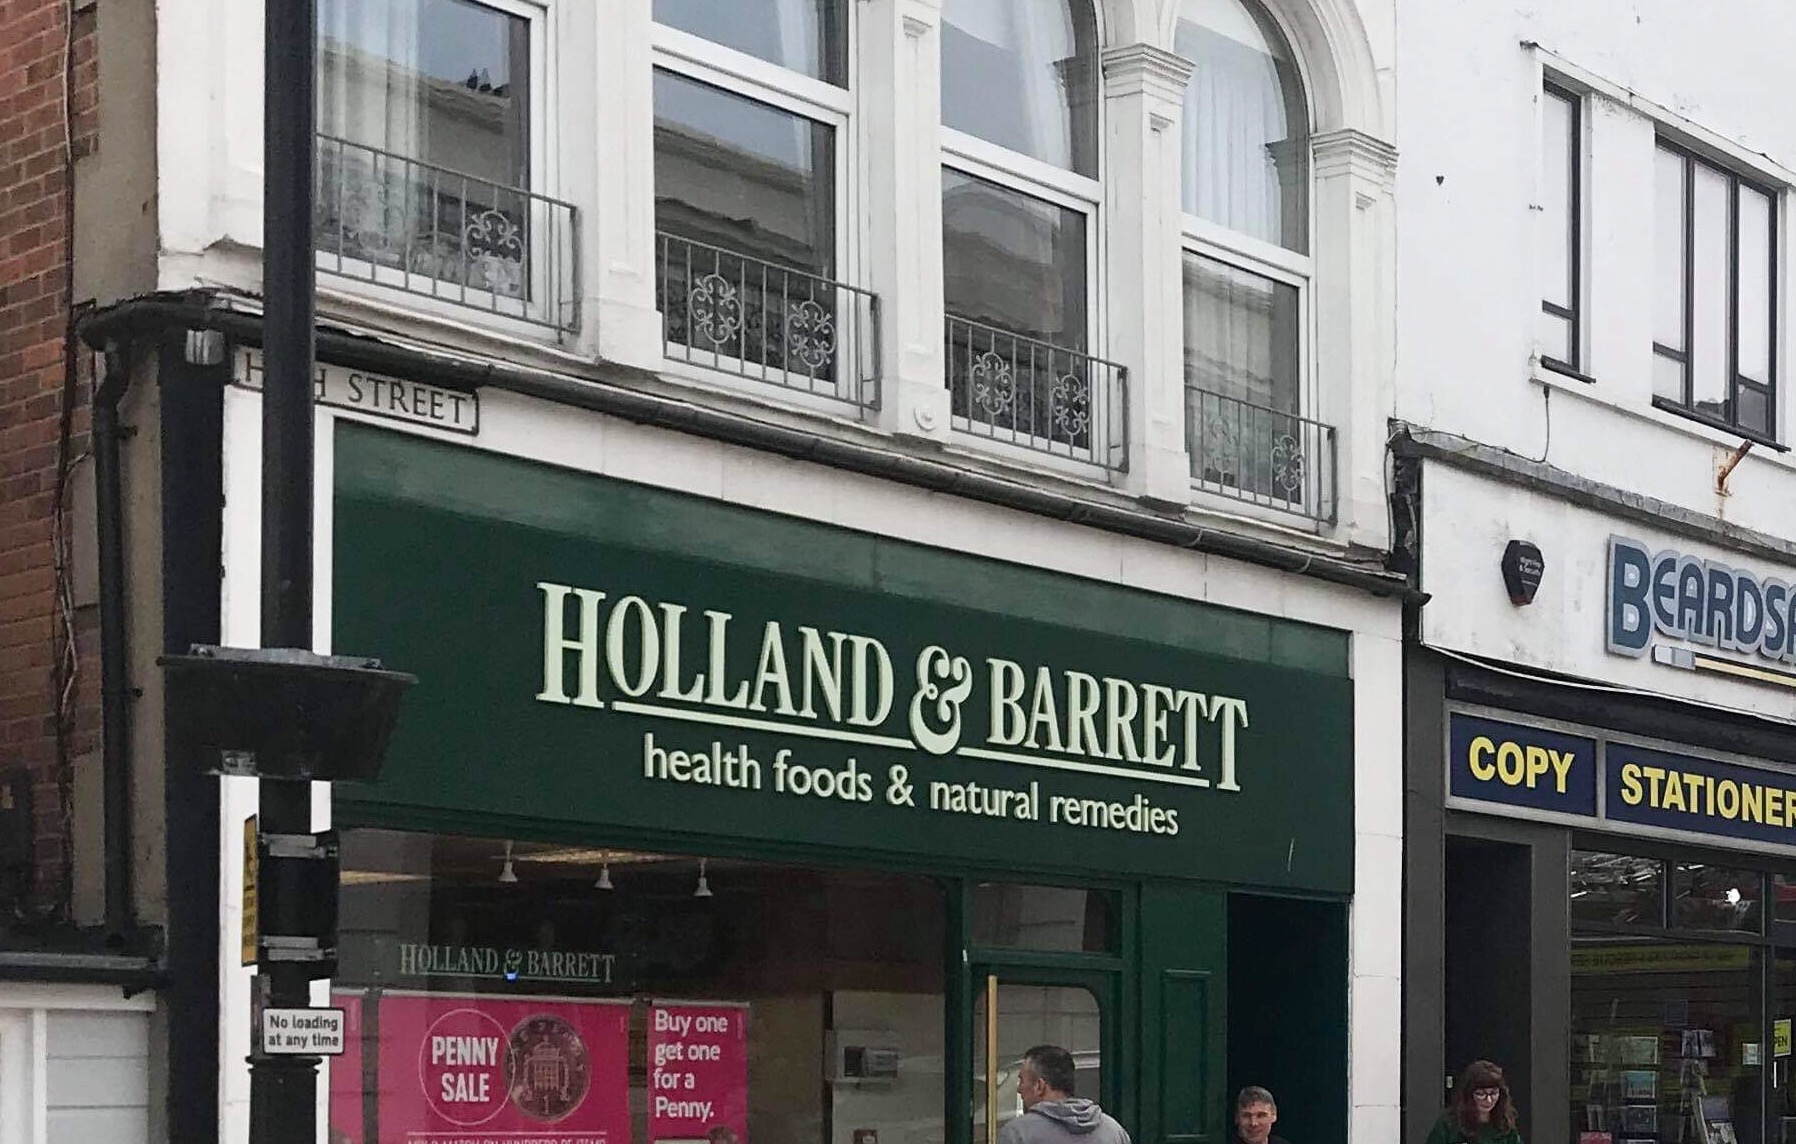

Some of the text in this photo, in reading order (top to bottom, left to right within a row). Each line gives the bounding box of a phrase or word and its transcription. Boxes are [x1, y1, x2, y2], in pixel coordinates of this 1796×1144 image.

[348, 373, 467, 424] STREET
[535, 582, 1249, 792] HOLLAND & BARRETT
[1468, 736, 1575, 794] COPY
[644, 732, 1179, 836] health foods & natural remedies
[401, 944, 616, 984] HOLLAND & BARRETT
[269, 1014, 338, 1032] No loading
[655, 1009, 728, 1037] Buy one
[268, 1033, 339, 1049] at any time
[432, 1036, 499, 1067] PENNY
[655, 1042, 721, 1066] get one
[441, 1072, 490, 1103] SALE
[653, 1067, 695, 1089] for a
[655, 1096, 715, 1123] Penny.
